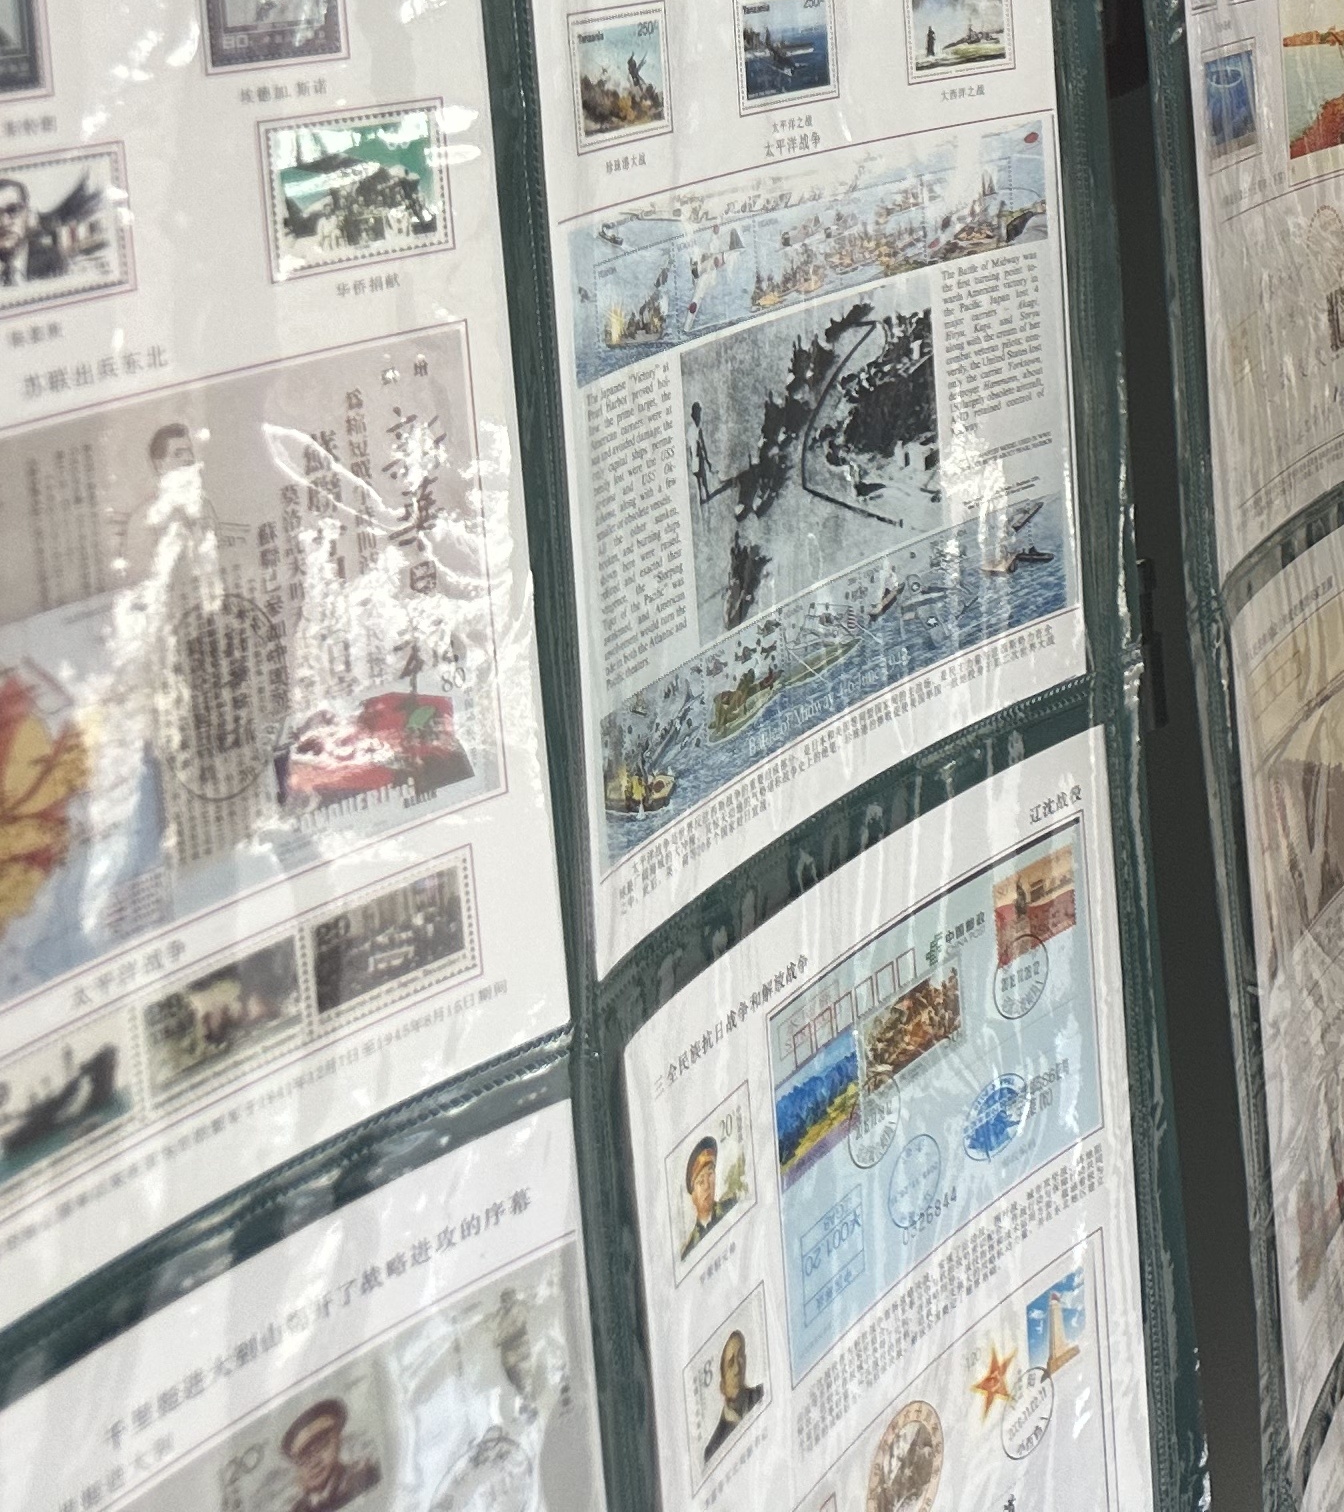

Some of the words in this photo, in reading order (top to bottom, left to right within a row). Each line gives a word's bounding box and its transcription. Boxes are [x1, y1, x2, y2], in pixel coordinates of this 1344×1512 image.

[763, 130, 823, 160] 太平洋战争
